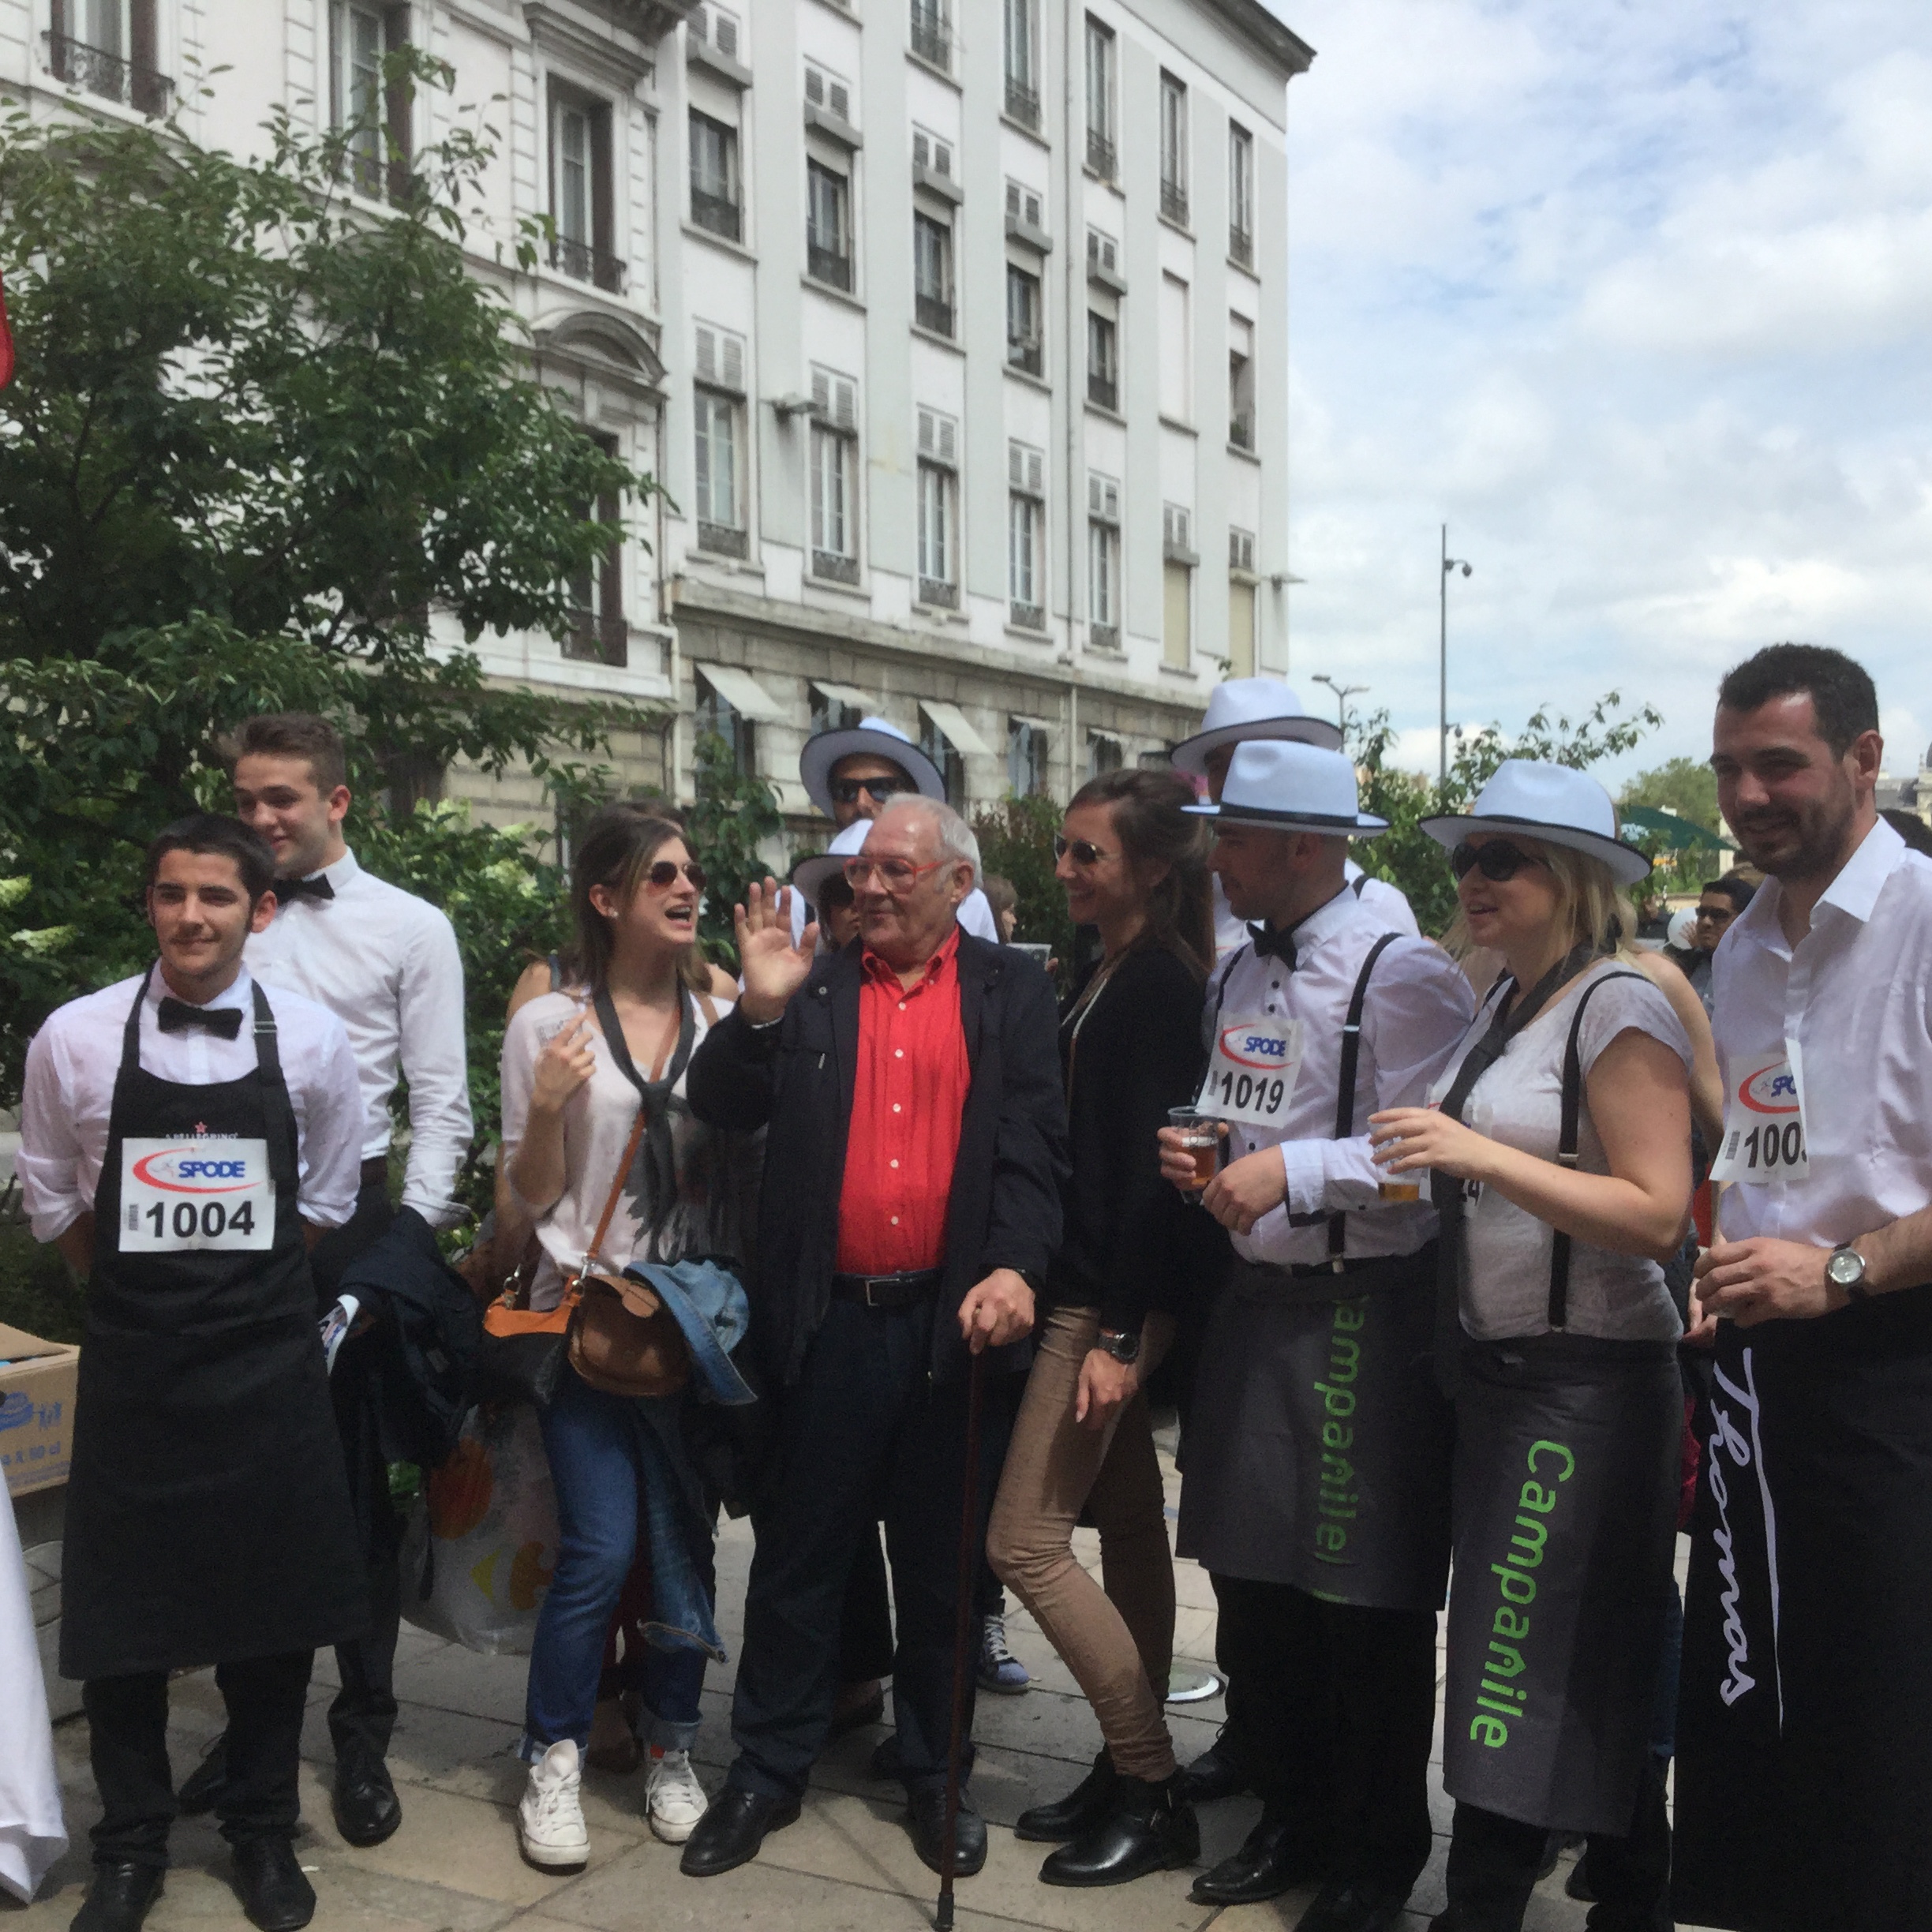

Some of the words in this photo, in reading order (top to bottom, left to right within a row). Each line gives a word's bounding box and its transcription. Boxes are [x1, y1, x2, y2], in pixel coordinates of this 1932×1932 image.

[1244, 1036, 1287, 1057] SPODE
[1221, 1071, 1284, 1114] 1019
[1744, 1121, 1807, 1168] 100
[178, 1160, 245, 1178] SPODE
[146, 1200, 255, 1238] 1004
[1313, 1294, 1370, 1552] ampanile
[1709, 1347, 1783, 1736] Thomas
[1470, 1440, 1575, 1748] Campanile
